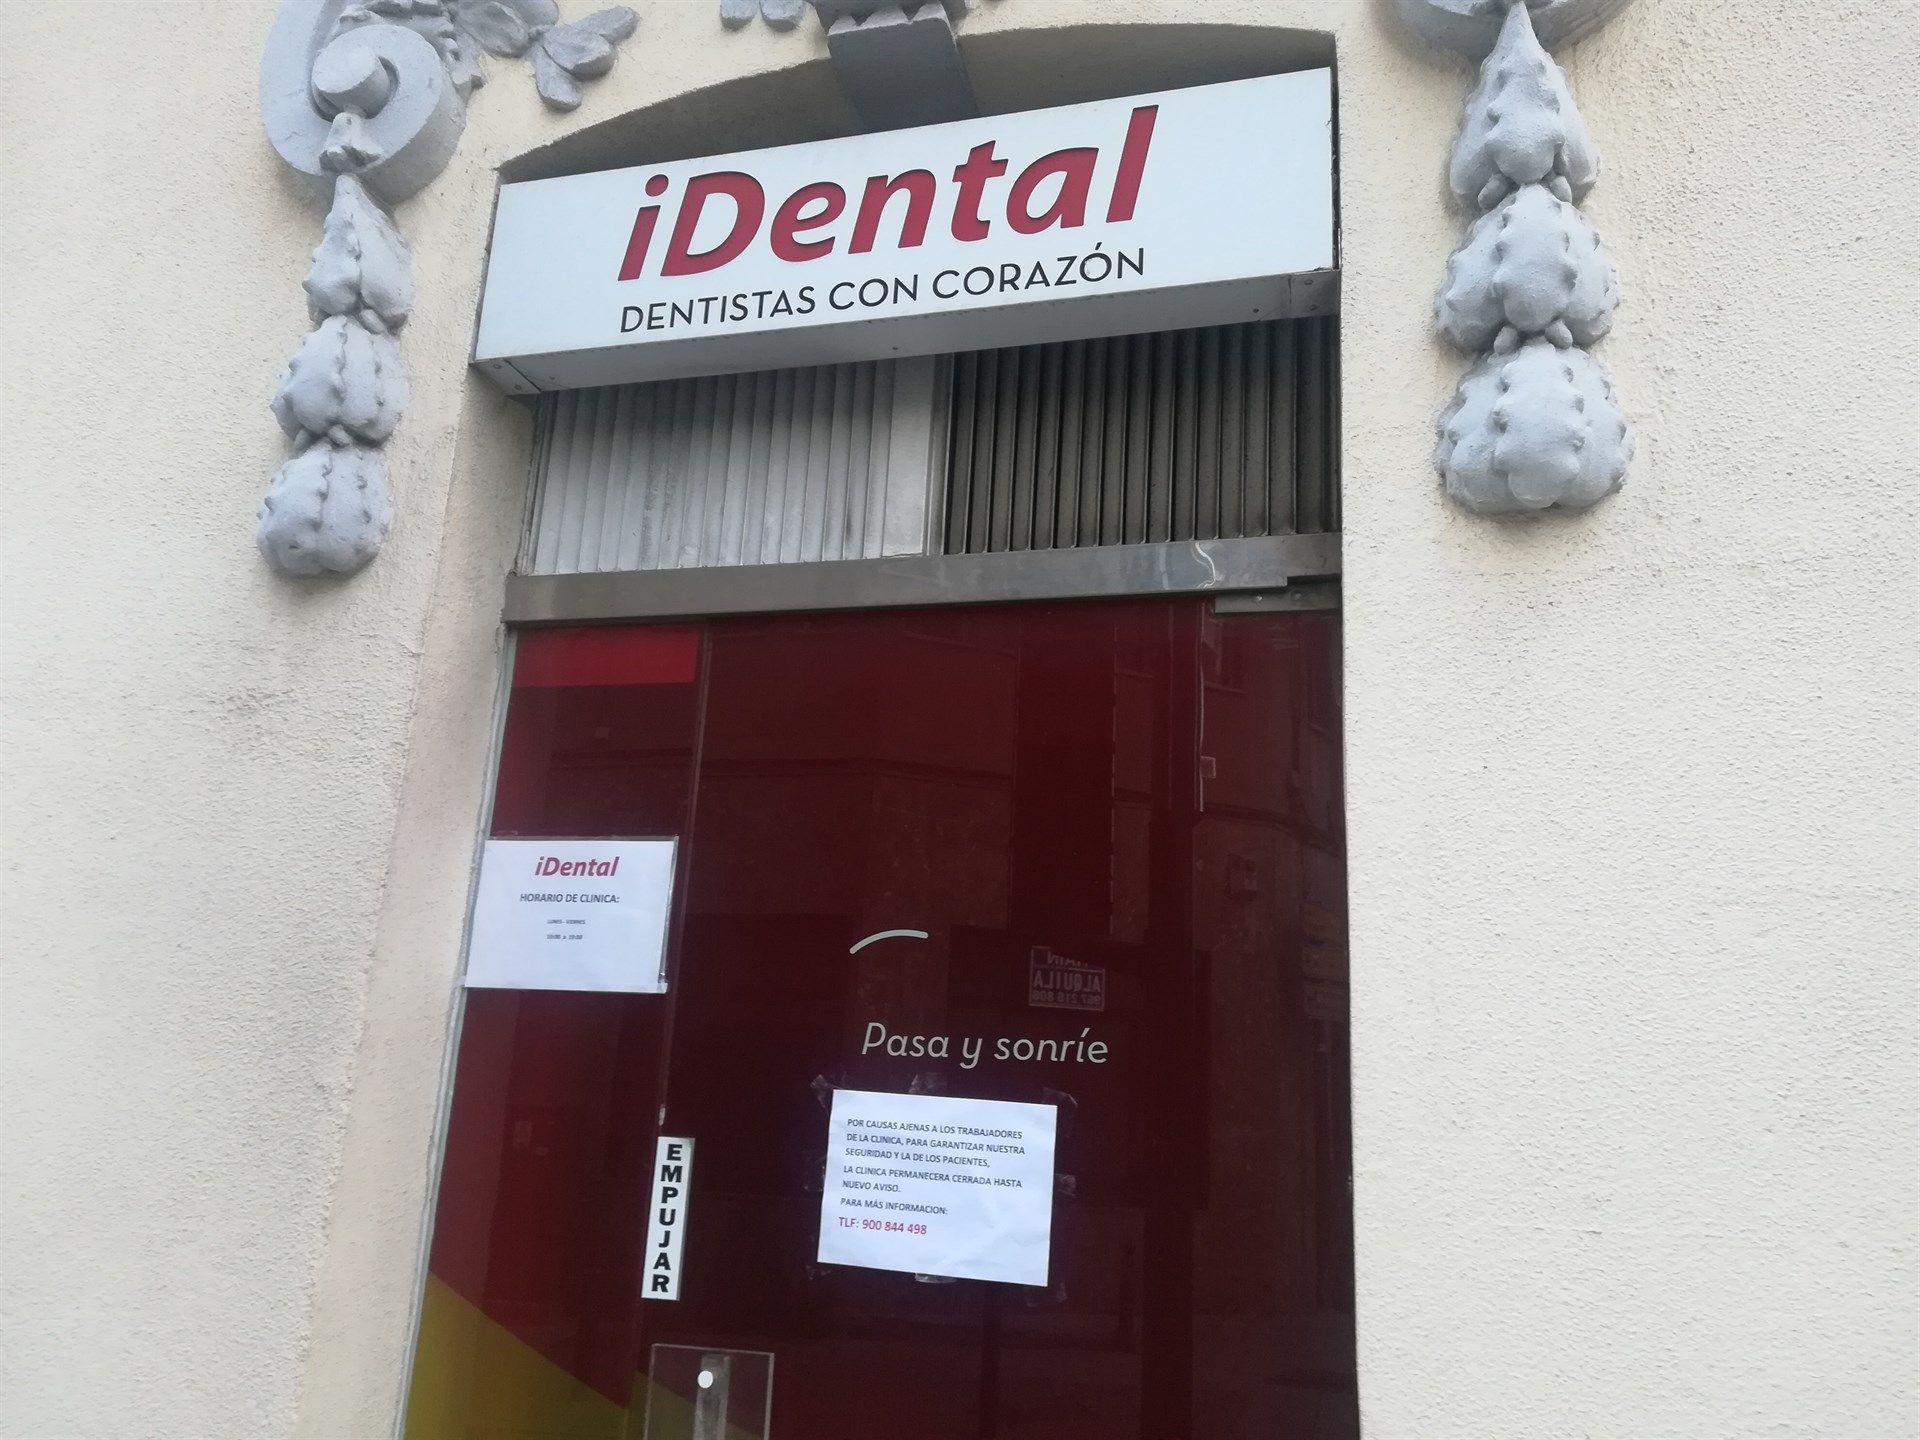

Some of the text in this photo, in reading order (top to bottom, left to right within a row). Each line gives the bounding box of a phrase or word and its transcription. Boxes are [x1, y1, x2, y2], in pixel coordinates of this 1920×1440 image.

[617, 104, 1159, 282] iDental
[620, 242, 1145, 333] DENTISTAS CON CORAZÓN
[535, 856, 620, 876] iDental
[520, 893, 620, 903] HORARIO DE CLINICA:
[861, 1022, 1108, 1069] Pasa y sonríe
[847, 1118, 1023, 1140] POR CAUSAS AJENAS A LOS TRABAJADORES
[847, 1133, 1025, 1155] DE LA CLINICA, PARA GARANTIZAR NUESTRA
[845, 1148, 990, 1168] SEGURIDAD Y LA DE LOS PACIENTES,
[842, 1180, 901, 1193] NUEVO AVISO.
[843, 1165, 1022, 1188] LA CLINICA PERMANECERA CERRADA HASTA
[840, 1197, 948, 1215] PARA MÁS INFORMACION:
[651, 1143, 683, 1293] EMPUJAR
[838, 1216, 927, 1235] TLF: 900 844 498
